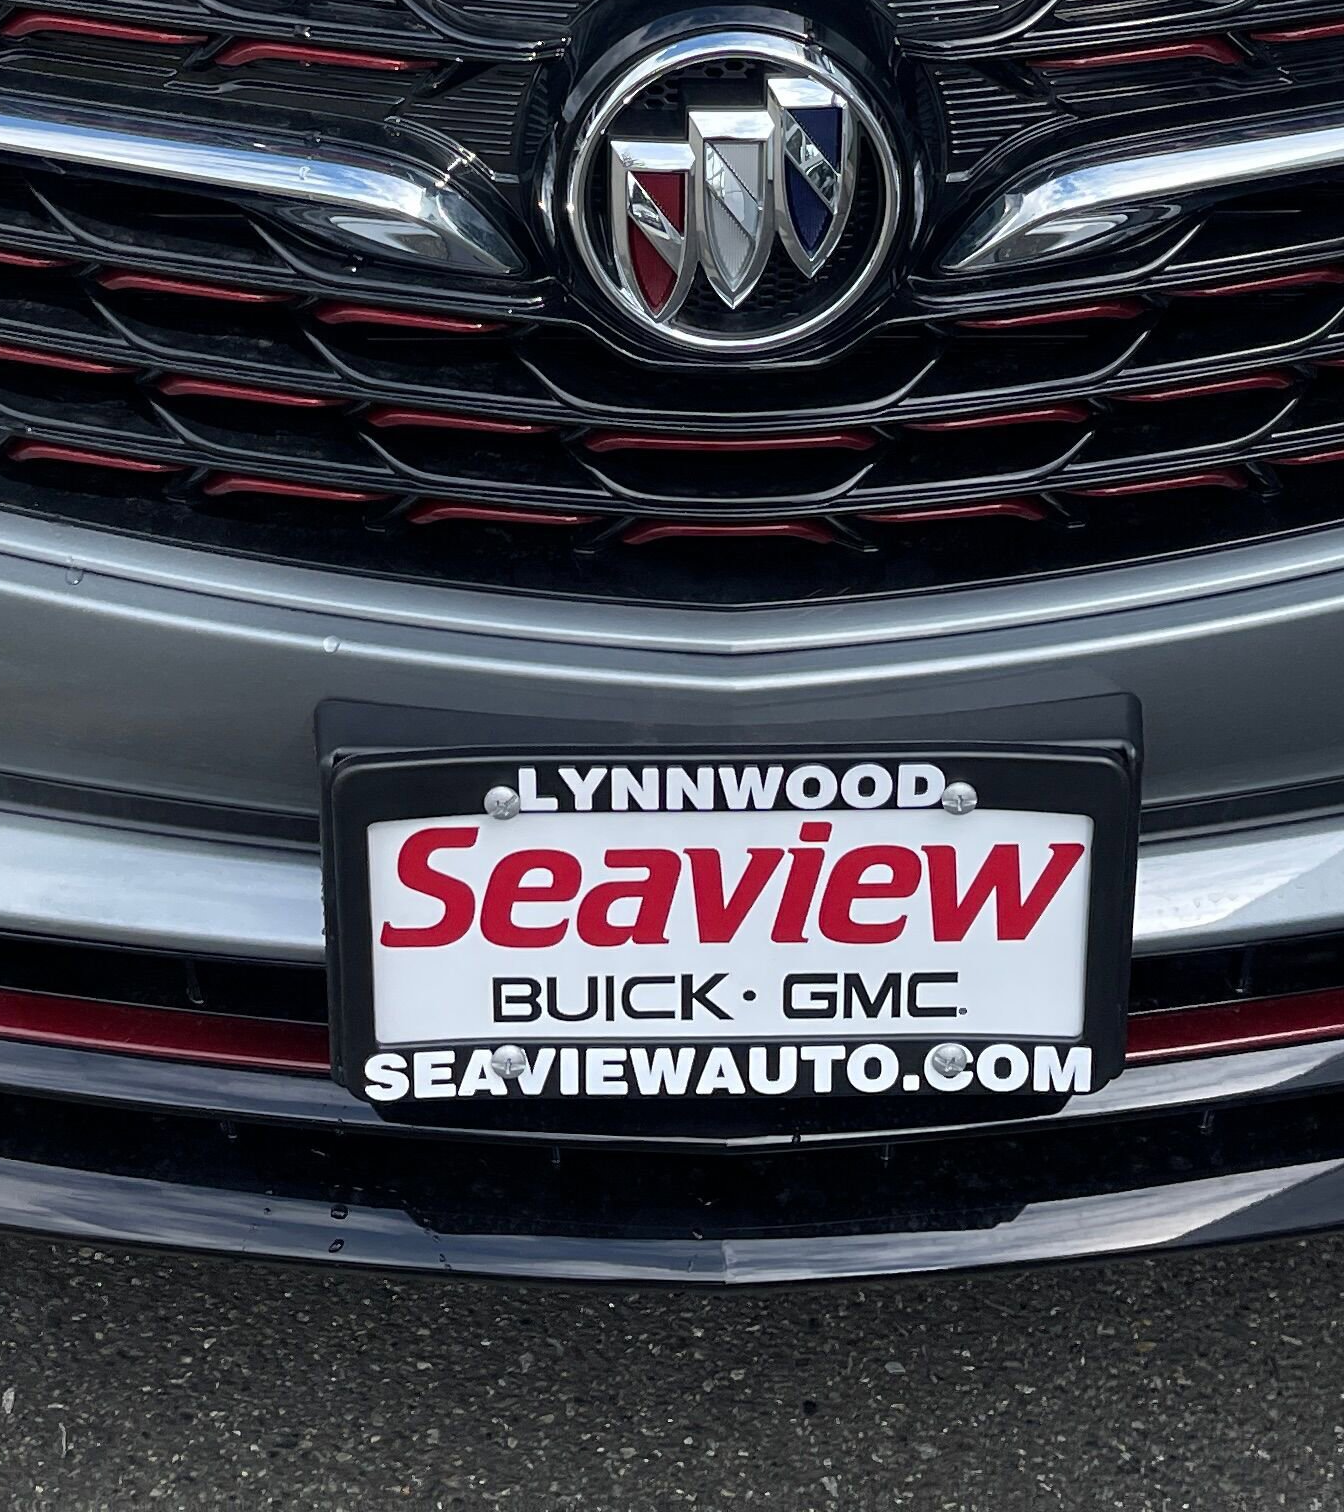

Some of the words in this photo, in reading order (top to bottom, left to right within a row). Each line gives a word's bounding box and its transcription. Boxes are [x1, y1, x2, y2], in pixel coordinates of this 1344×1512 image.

[517, 763, 946, 813] LYNNWOOD
[379, 821, 1086, 949] Seaview
[492, 972, 734, 1023] BUICK
[364, 1045, 1092, 1103] SEAVIEWAUTO.COM
